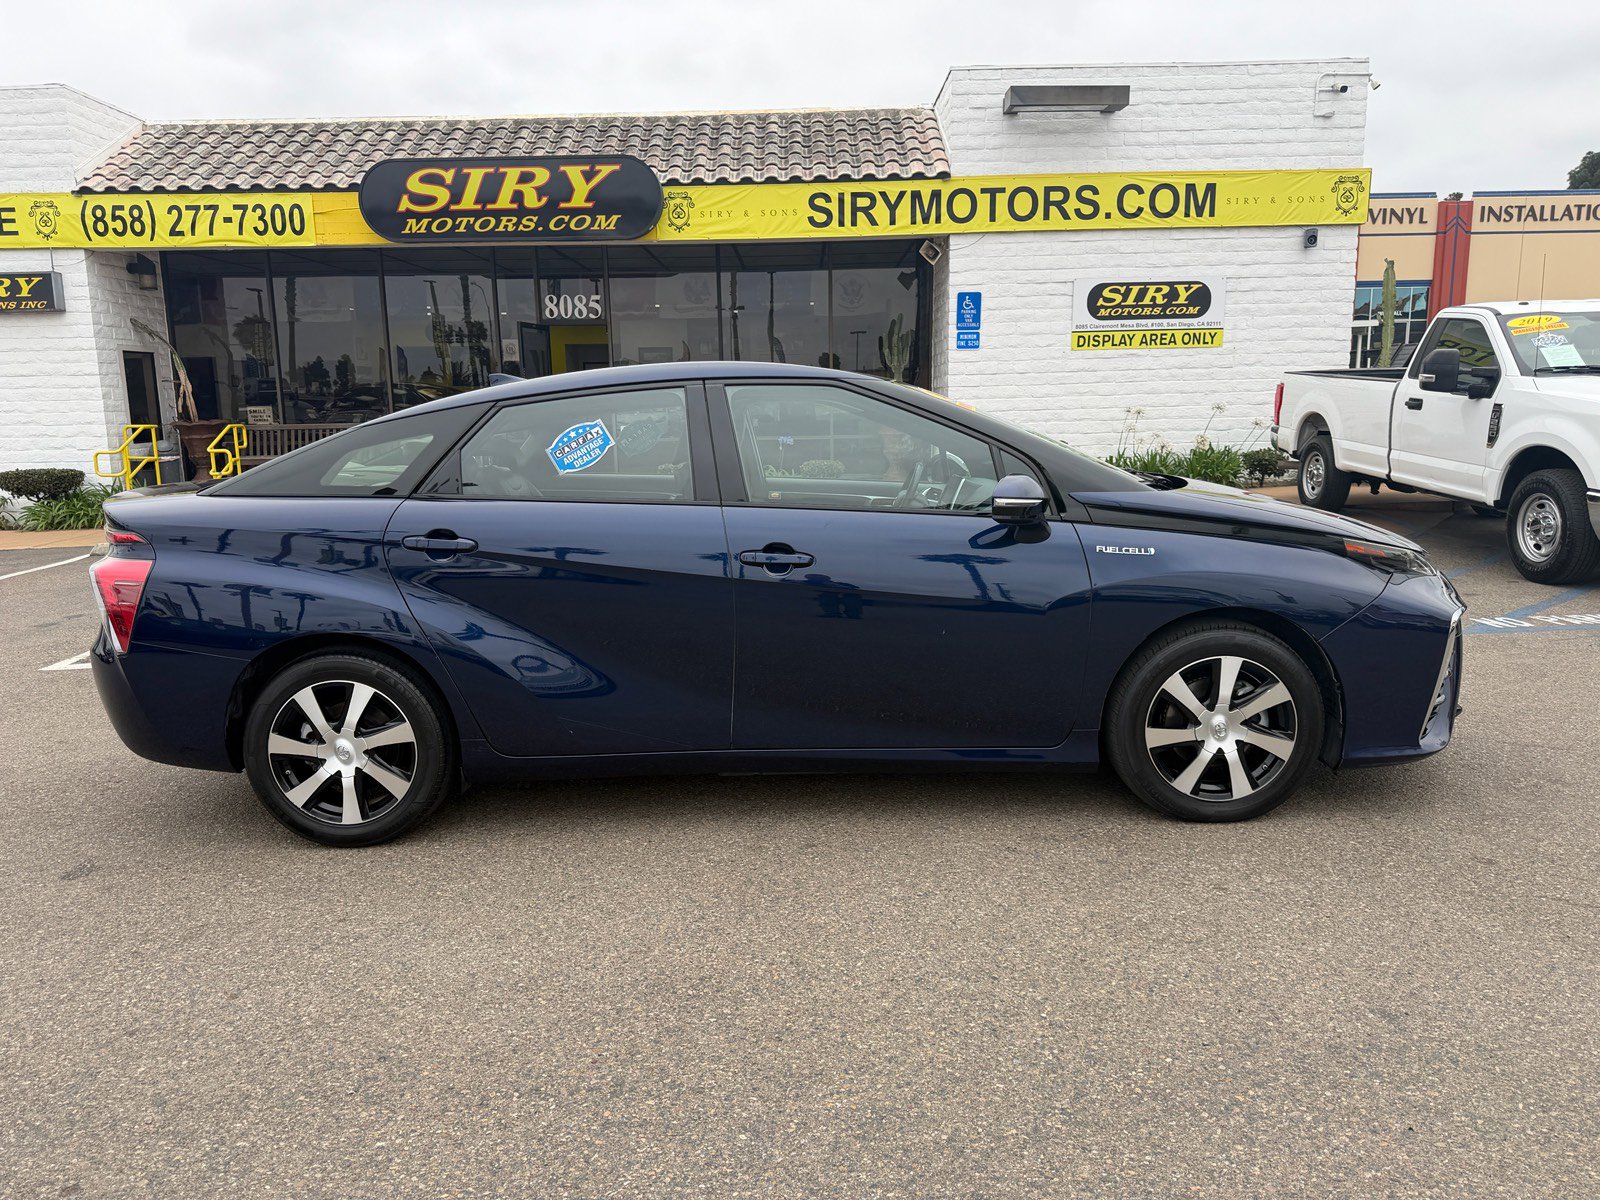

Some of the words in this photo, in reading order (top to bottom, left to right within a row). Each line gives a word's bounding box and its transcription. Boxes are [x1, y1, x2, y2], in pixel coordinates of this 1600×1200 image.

[397, 163, 622, 214] SIRY
[806, 182, 1217, 228] SIRYMOTORS.COM
[1225, 196, 1260, 206] SIRY
[1269, 196, 1277, 204] &
[1287, 195, 1326, 204] SONS
[80, 199, 156, 242] (858)
[166, 203, 306, 237] 277-7300
[699, 209, 733, 219] SIRY
[743, 209, 751, 218] &
[760, 208, 799, 217] SONS
[1368, 207, 1428, 225] VINYL
[401, 214, 622, 234] MOTORS.COM
[19, 300, 48, 309] INC
[1097, 284, 1202, 306] SIRY
[544, 294, 602, 319] 8085
[1097, 306, 1201, 317] MOTORS.COM
[1089, 322, 1119, 330] Clairemont
[1076, 333, 1136, 348] DISPLAY
[1139, 332, 1177, 347] AREA
[1181, 331, 1218, 346] ONLY
[553, 427, 602, 458] CARFAX
[563, 437, 605, 465] ADVANTAGE
[573, 448, 602, 468] DEALER
[1096, 545, 1149, 555] FUELCELL
